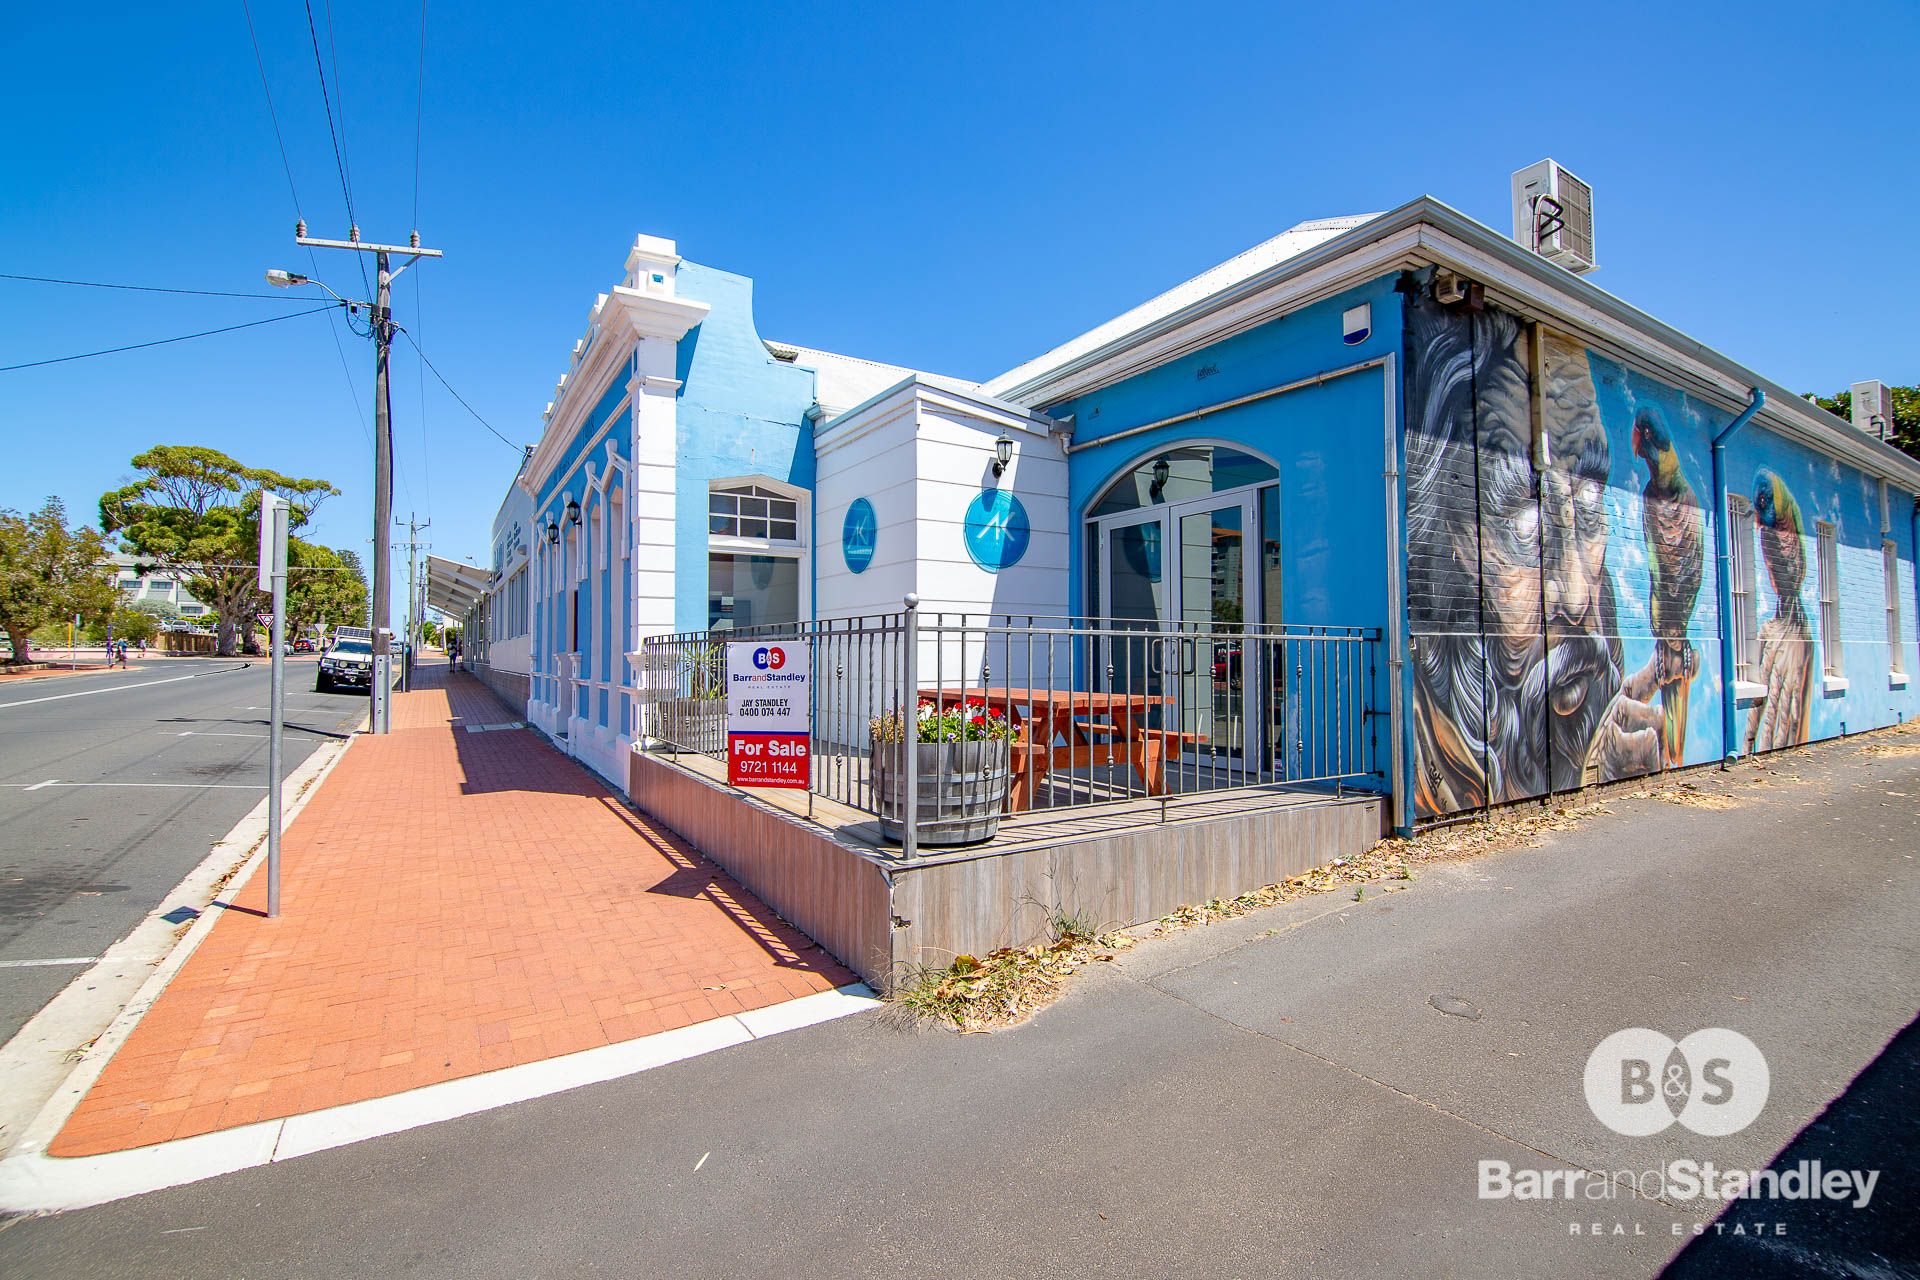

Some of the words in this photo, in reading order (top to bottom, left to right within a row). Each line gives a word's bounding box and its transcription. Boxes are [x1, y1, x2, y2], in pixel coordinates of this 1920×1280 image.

[758, 653, 780, 664] B&S
[733, 673, 806, 683] BarrandStandley
[741, 699, 754, 707] JAY
[755, 699, 788, 707] STANDLEY
[739, 708, 759, 717] 0400
[761, 708, 774, 717] 074
[777, 708, 791, 717] 447
[734, 739, 763, 756] For
[768, 740, 807, 757] Sale
[740, 760, 767, 773] 9721
[772, 761, 797, 774] 1144
[736, 776, 805, 785] www.barrandstandley.com.au
